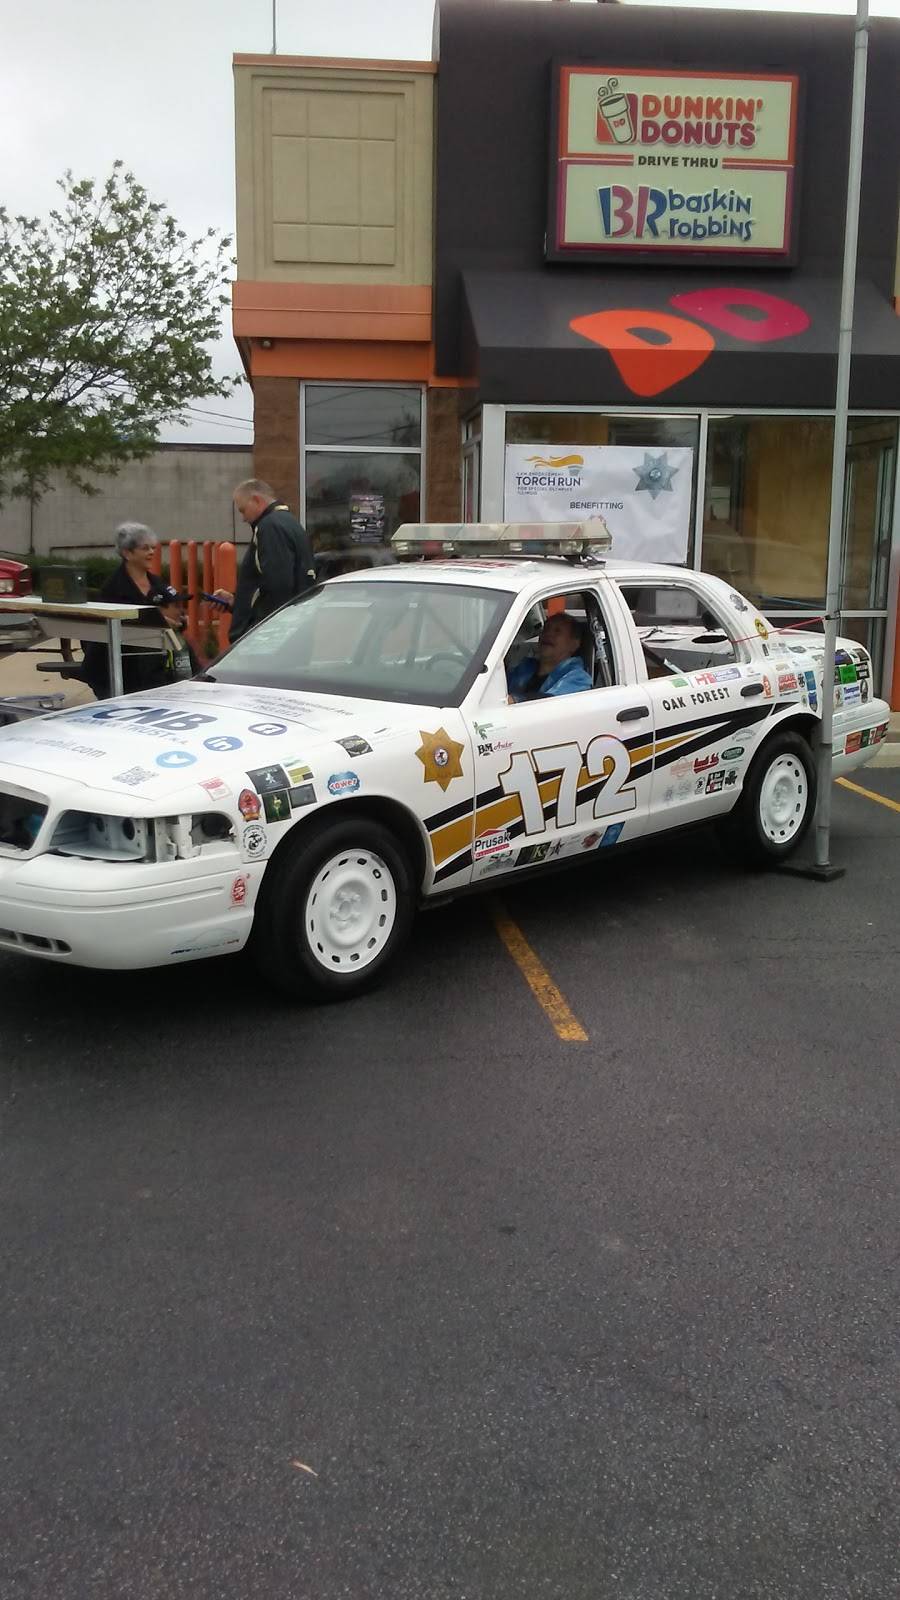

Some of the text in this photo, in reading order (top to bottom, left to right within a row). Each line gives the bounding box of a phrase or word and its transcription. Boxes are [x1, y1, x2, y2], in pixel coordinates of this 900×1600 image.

[642, 94, 763, 121] DUNKIN'
[641, 120, 756, 147] DONUTS
[638, 155, 719, 168] DRIVE THRU
[668, 188, 752, 214] baskin
[669, 215, 753, 241] robbins
[516, 476, 581, 487] TORCH RUN
[570, 501, 624, 510] BENEFITTING
[662, 687, 731, 711] OAK FOREST
[92, 706, 219, 731] CNB
[497, 734, 636, 836] 172
[474, 831, 512, 851] Prusak
